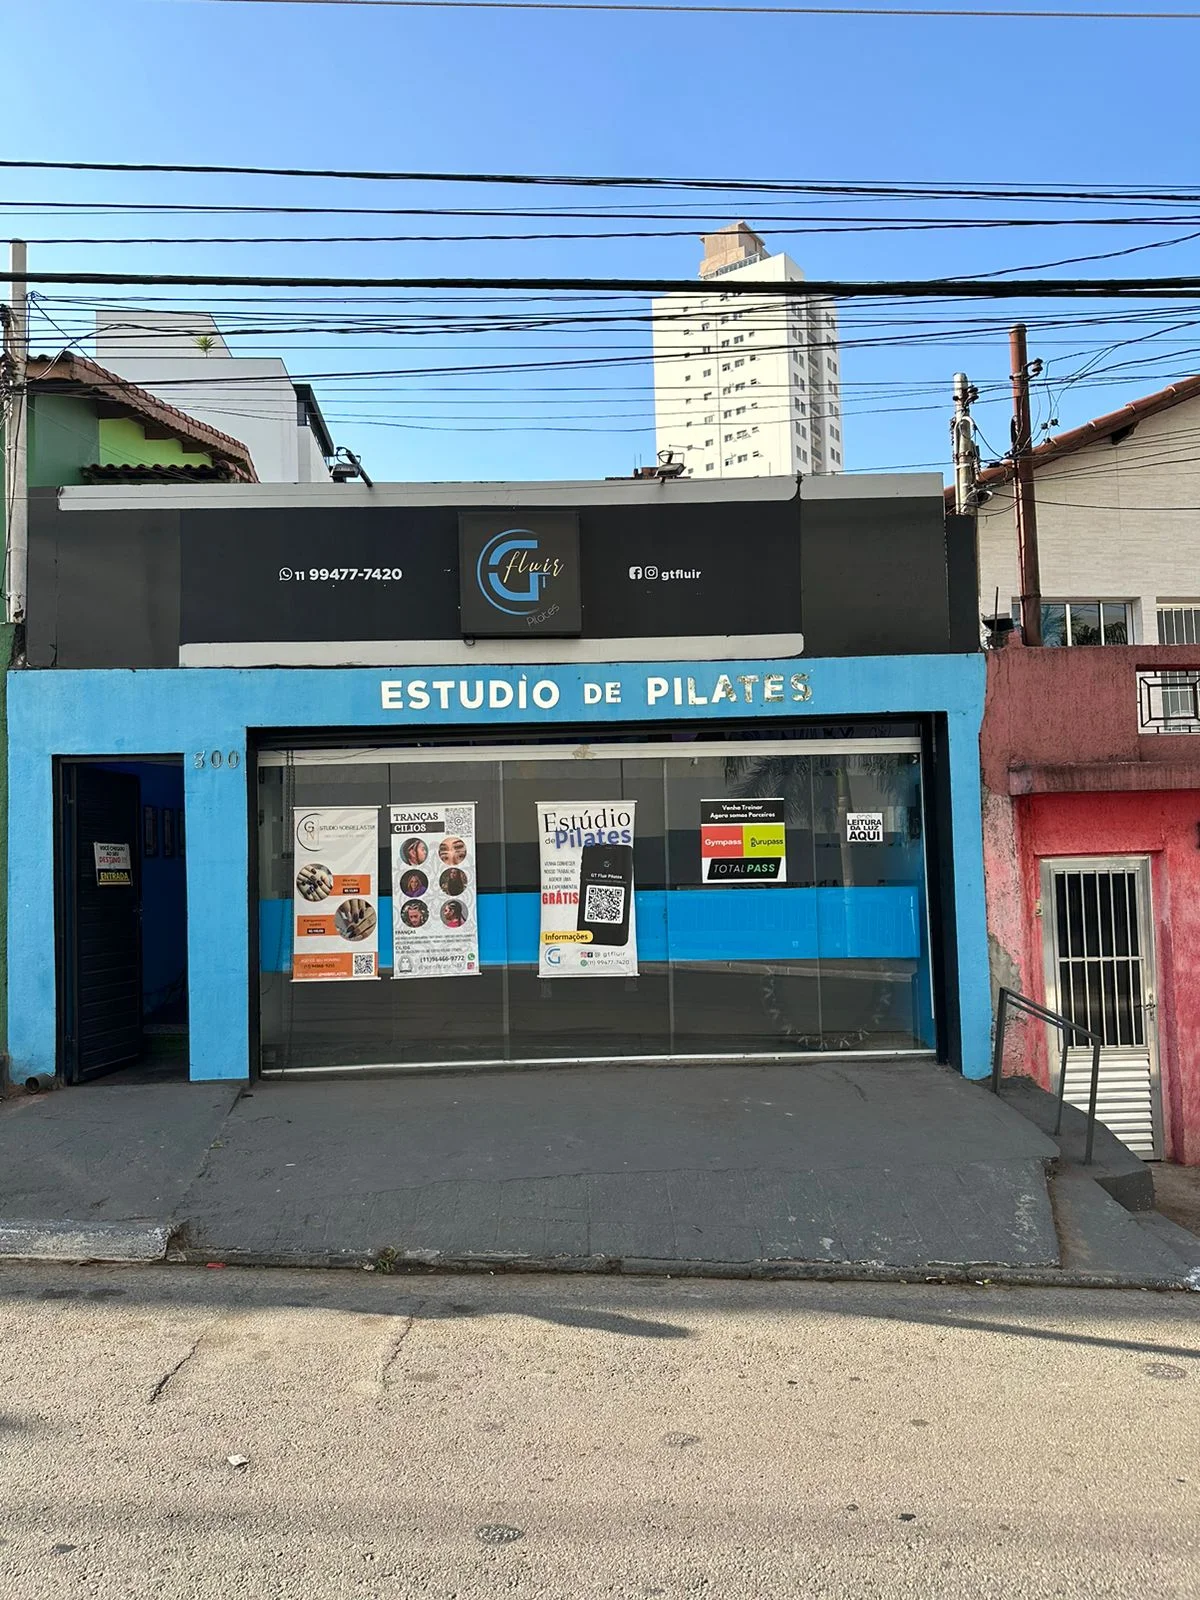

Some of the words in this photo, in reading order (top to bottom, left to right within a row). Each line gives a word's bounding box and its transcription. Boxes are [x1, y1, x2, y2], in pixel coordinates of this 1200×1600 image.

[503, 550, 565, 584] fluir
[294, 571, 305, 581] 11
[309, 568, 403, 581] 99477-7420
[661, 569, 702, 581] gtfluir
[526, 603, 560, 627] Pilates
[583, 682, 622, 704] DE
[647, 674, 813, 705] PILATES
[192, 750, 240, 769] 300
[393, 812, 439, 823] TRANÇAS
[543, 808, 631, 833] Estúdio
[394, 823, 427, 833] CILIOS
[555, 826, 632, 849] Pilates
[705, 838, 742, 847] Gympass
[848, 831, 880, 842] AQUI
[541, 889, 580, 905] GRÁTIS
[544, 932, 589, 942] Informações
